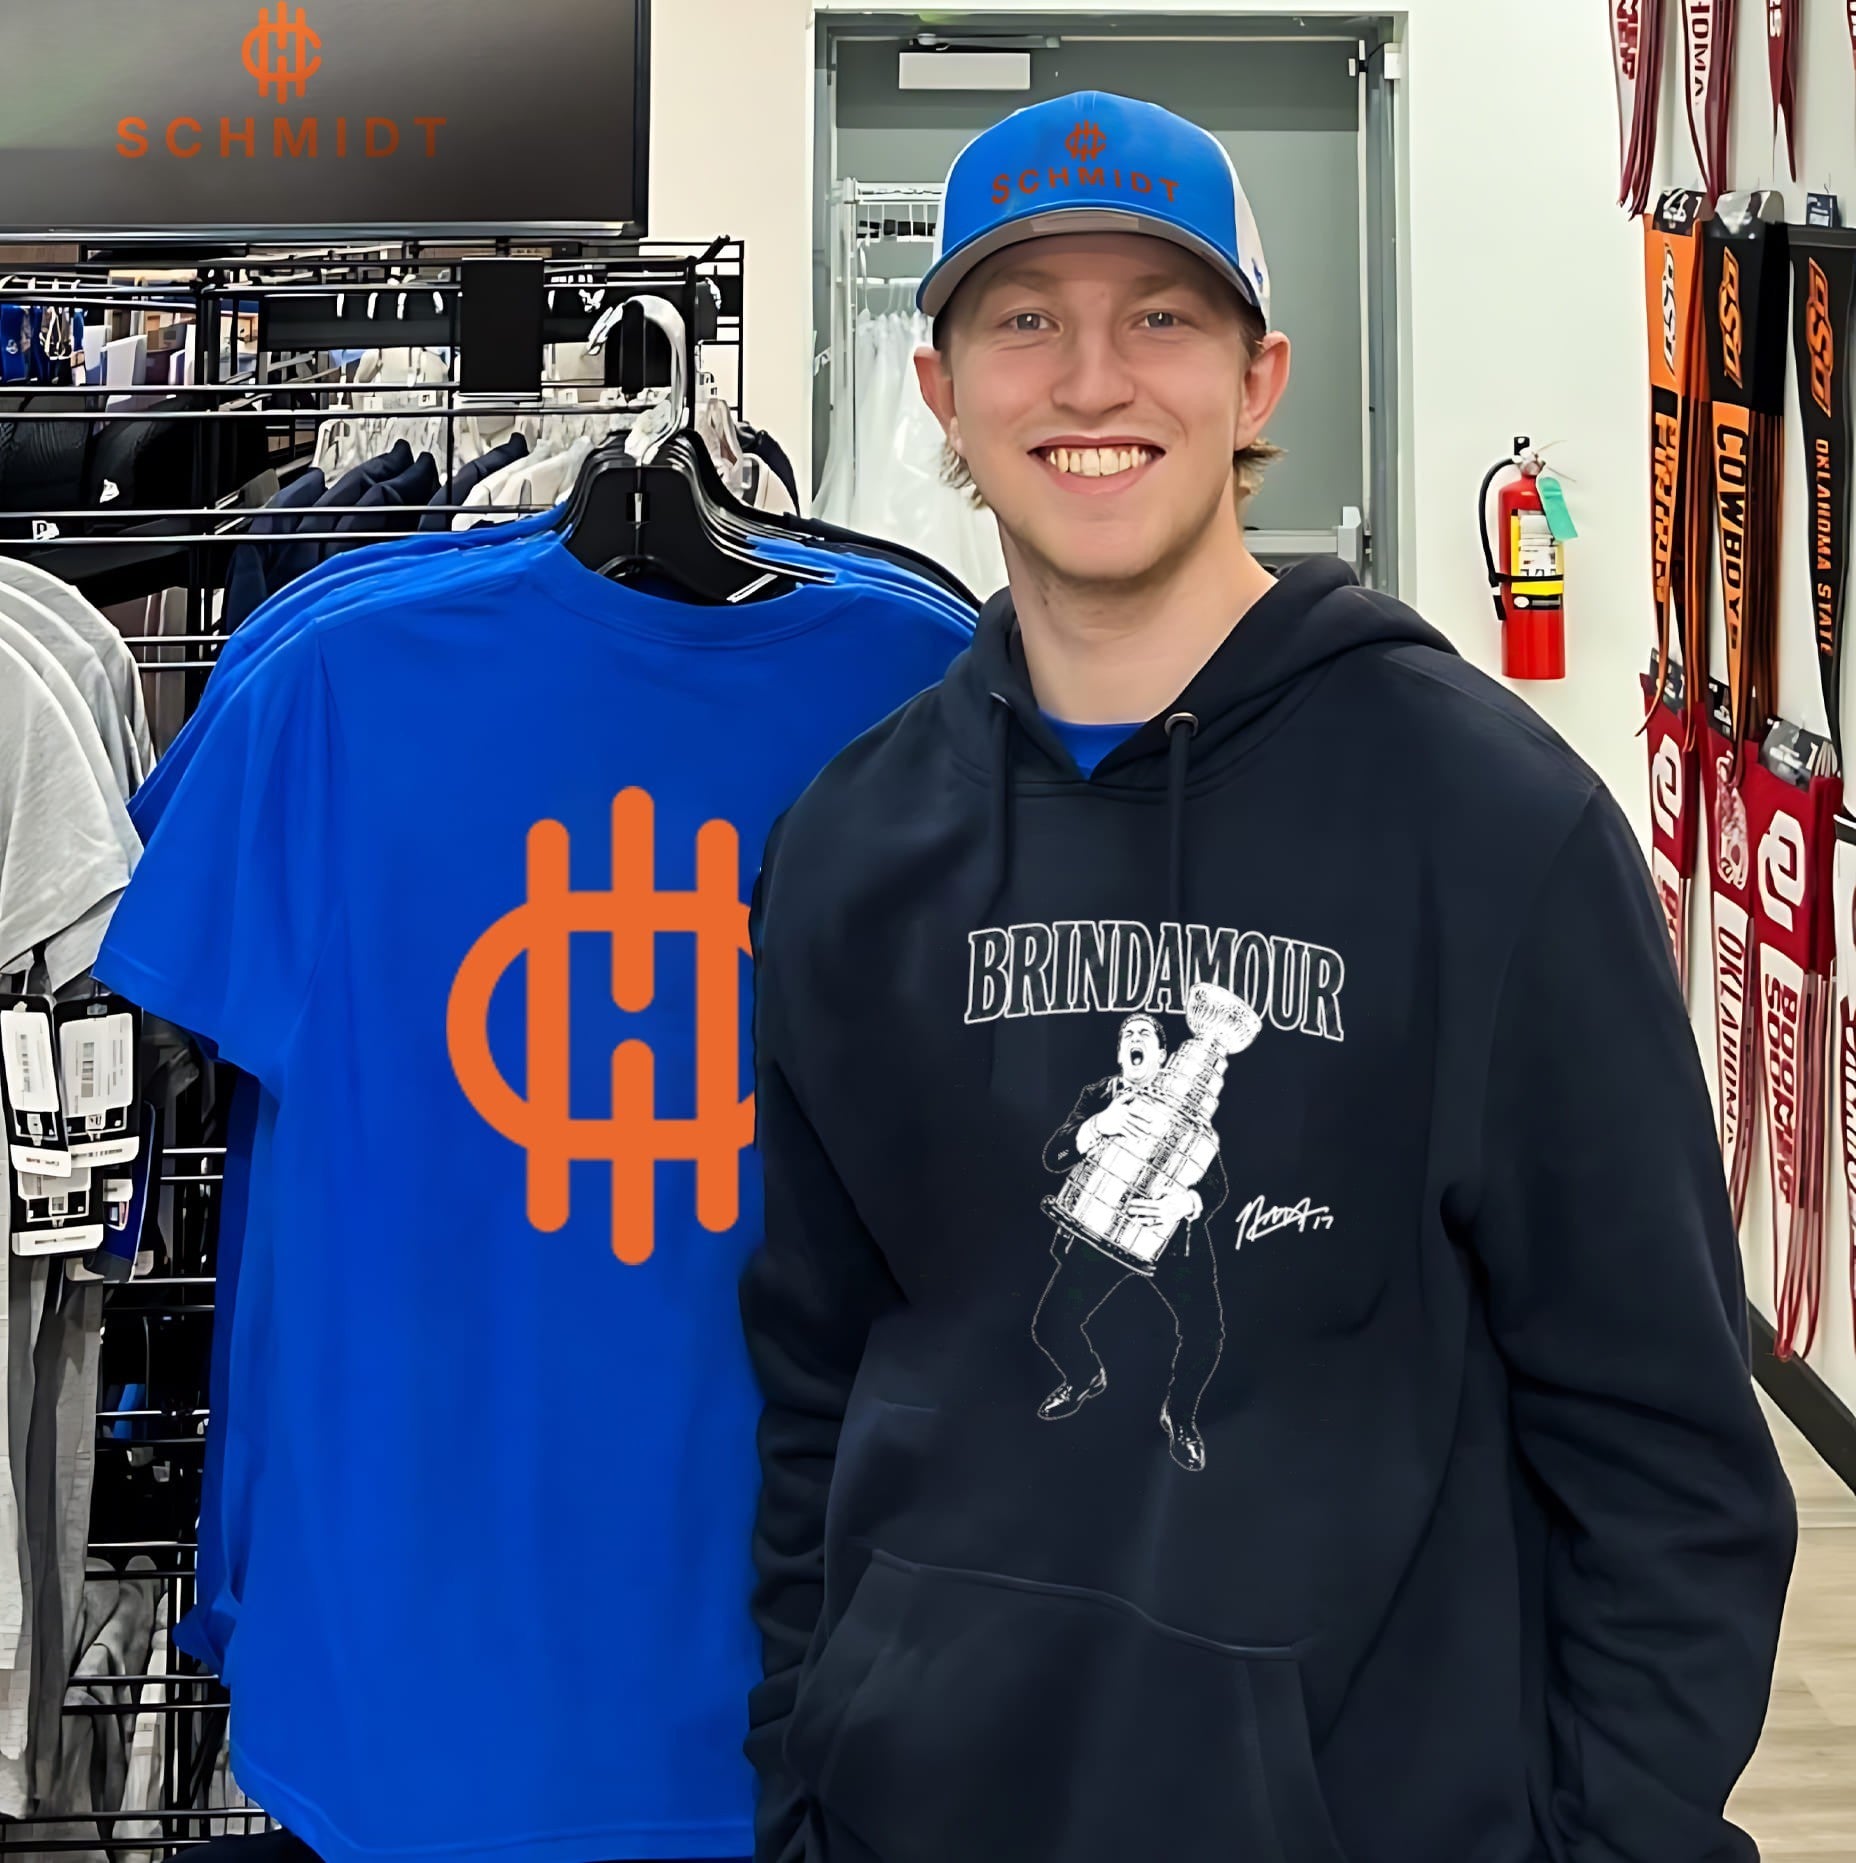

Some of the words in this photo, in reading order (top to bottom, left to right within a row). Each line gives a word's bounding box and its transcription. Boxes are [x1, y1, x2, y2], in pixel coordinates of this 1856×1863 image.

[116, 117, 448, 159] SCHMIDT
[992, 167, 1179, 204] SCHMIDT
[1815, 438, 1833, 571] OKLAHOMA
[964, 919, 1345, 1042] BRINDAMOUR
[1718, 926, 1746, 1144] OKLAHOMA
